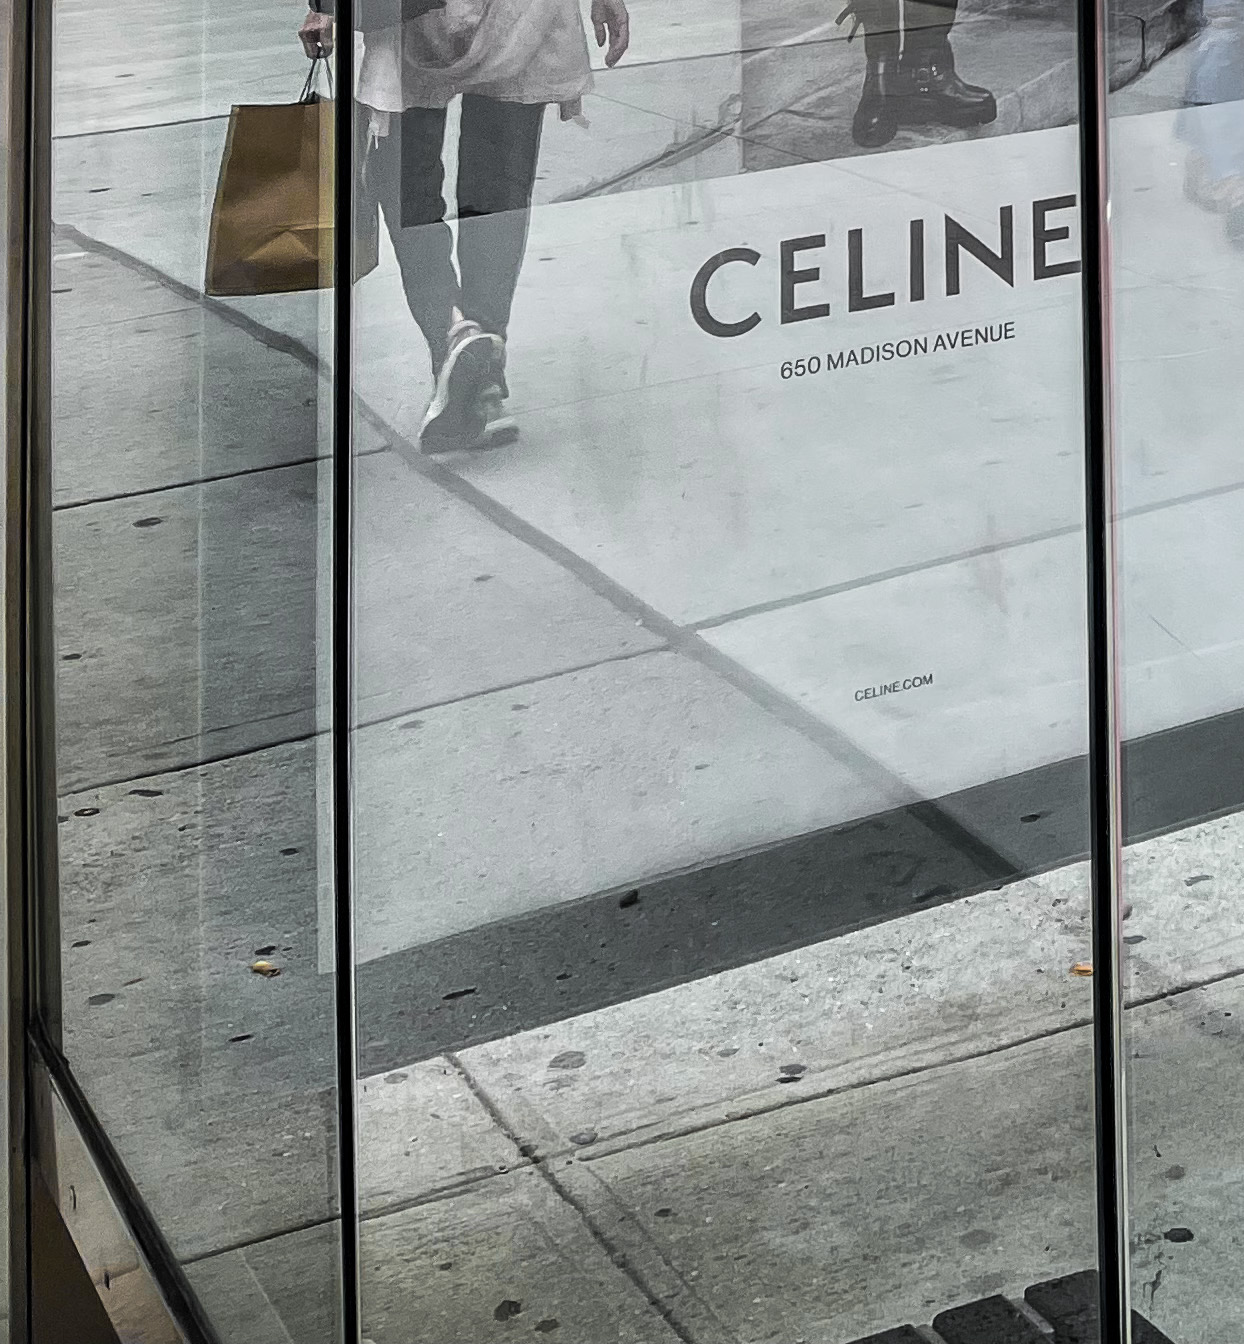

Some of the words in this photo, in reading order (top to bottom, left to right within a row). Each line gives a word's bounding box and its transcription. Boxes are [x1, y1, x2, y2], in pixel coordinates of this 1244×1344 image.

[689, 193, 1082, 339] CELINE
[779, 355, 821, 381] 650
[826, 337, 929, 373] MADISON
[932, 321, 1017, 354] AVENUE
[854, 673, 934, 703] CELINE.COM
